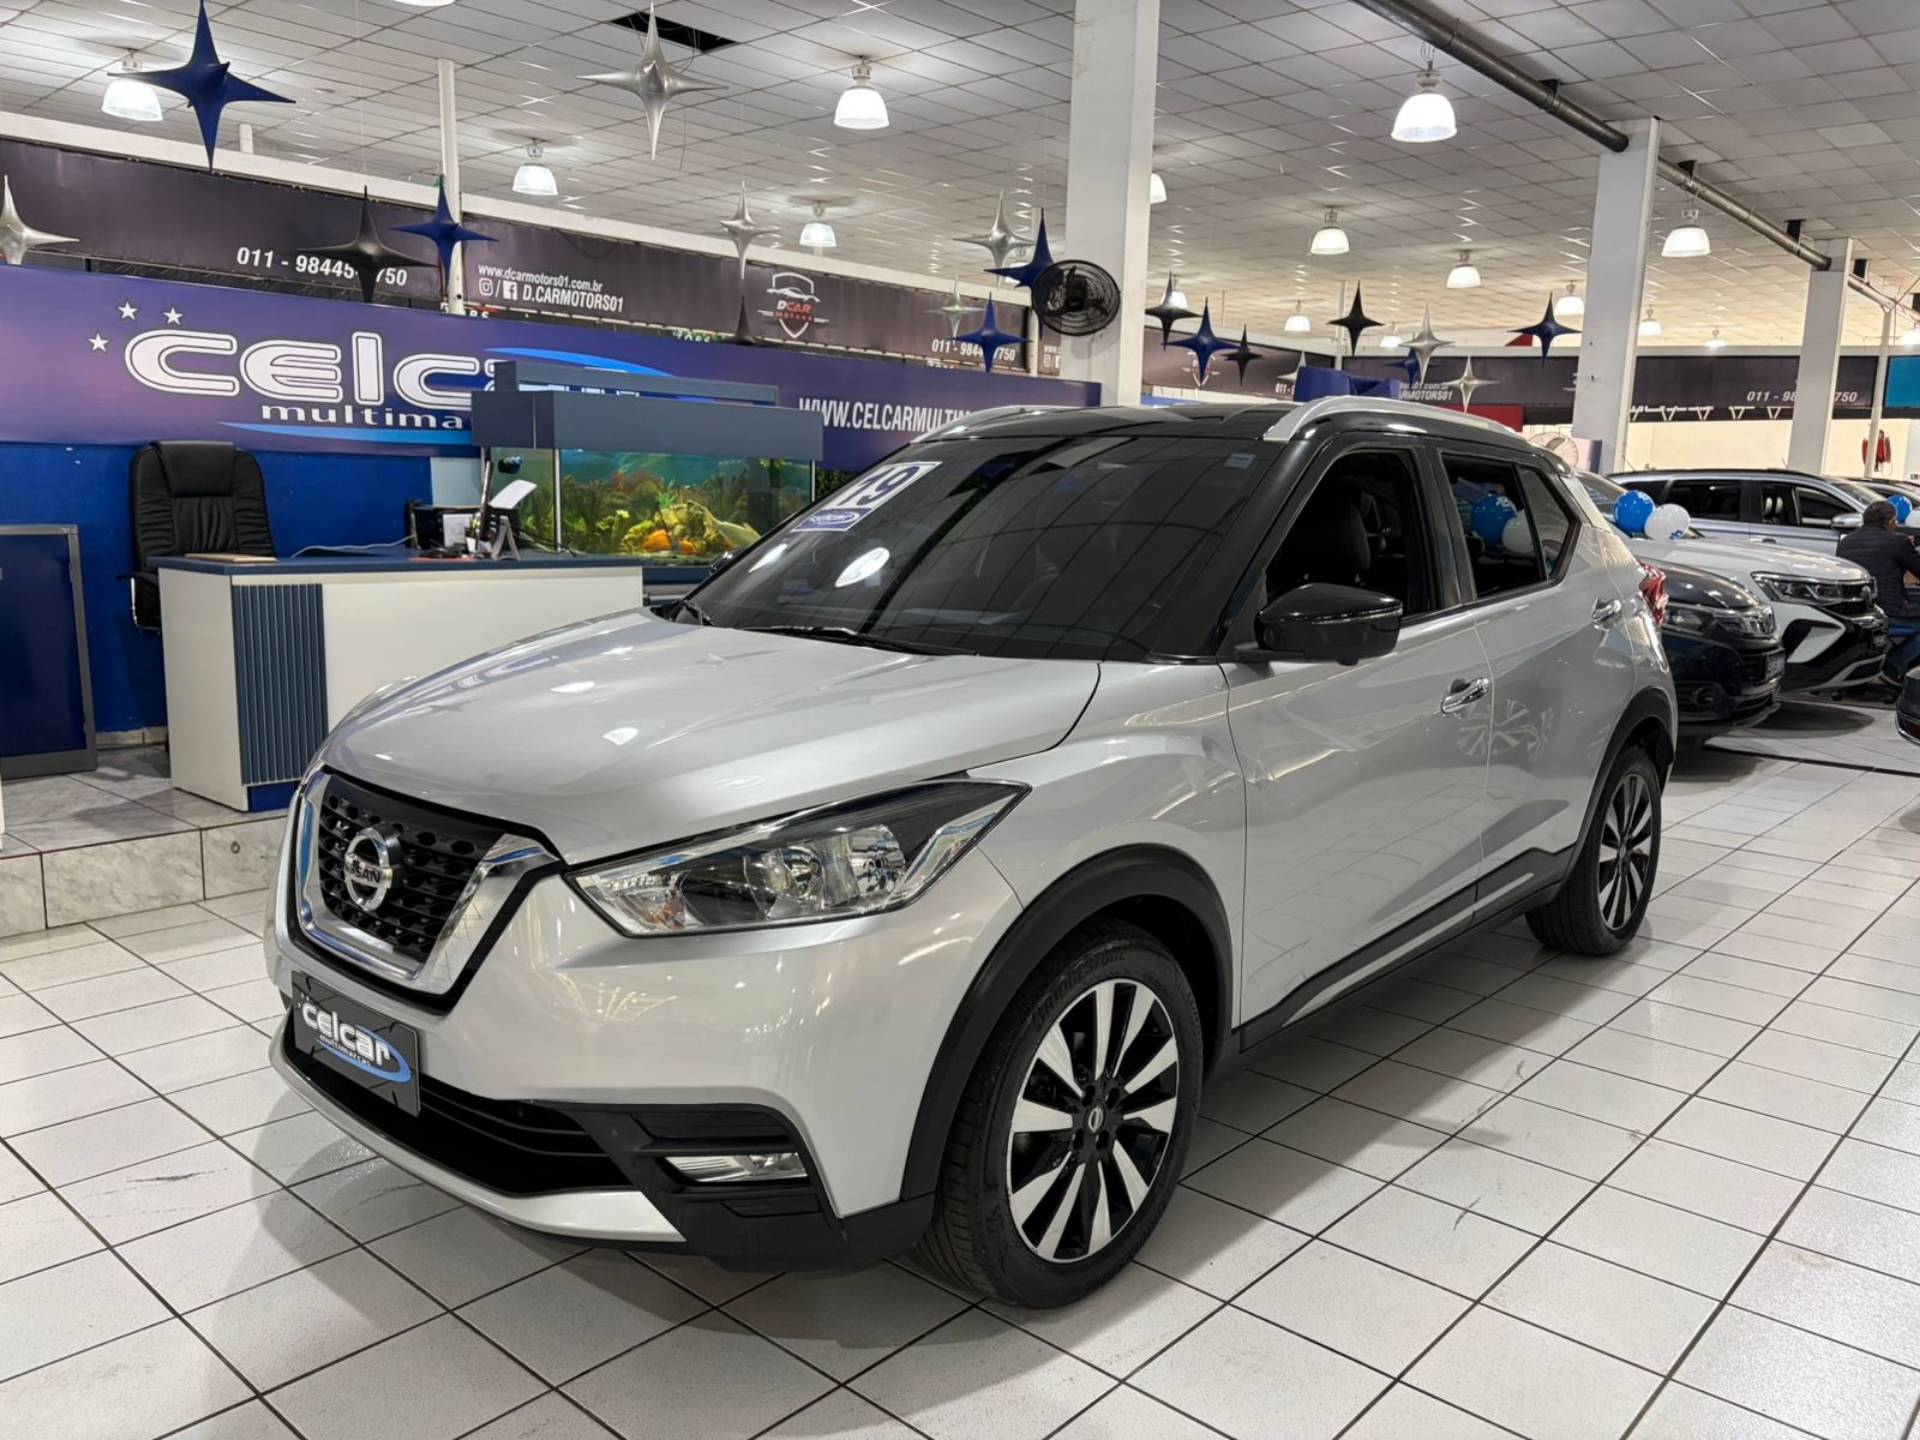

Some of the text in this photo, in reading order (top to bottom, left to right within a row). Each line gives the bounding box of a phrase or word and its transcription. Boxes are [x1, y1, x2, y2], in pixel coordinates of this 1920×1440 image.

[237, 246, 274, 268] 011
[295, 255, 408, 286] 98445-50
[478, 264, 603, 292] www.dcarmotors01.com.br
[522, 285, 624, 313] D.CARMOTORS01
[931, 338, 951, 354] 011
[125, 329, 510, 411] celc
[1399, 390, 1453, 400] RMOTORS01
[1746, 390, 1770, 402] 011
[262, 404, 463, 429] multima
[302, 1002, 391, 1066] celcar
